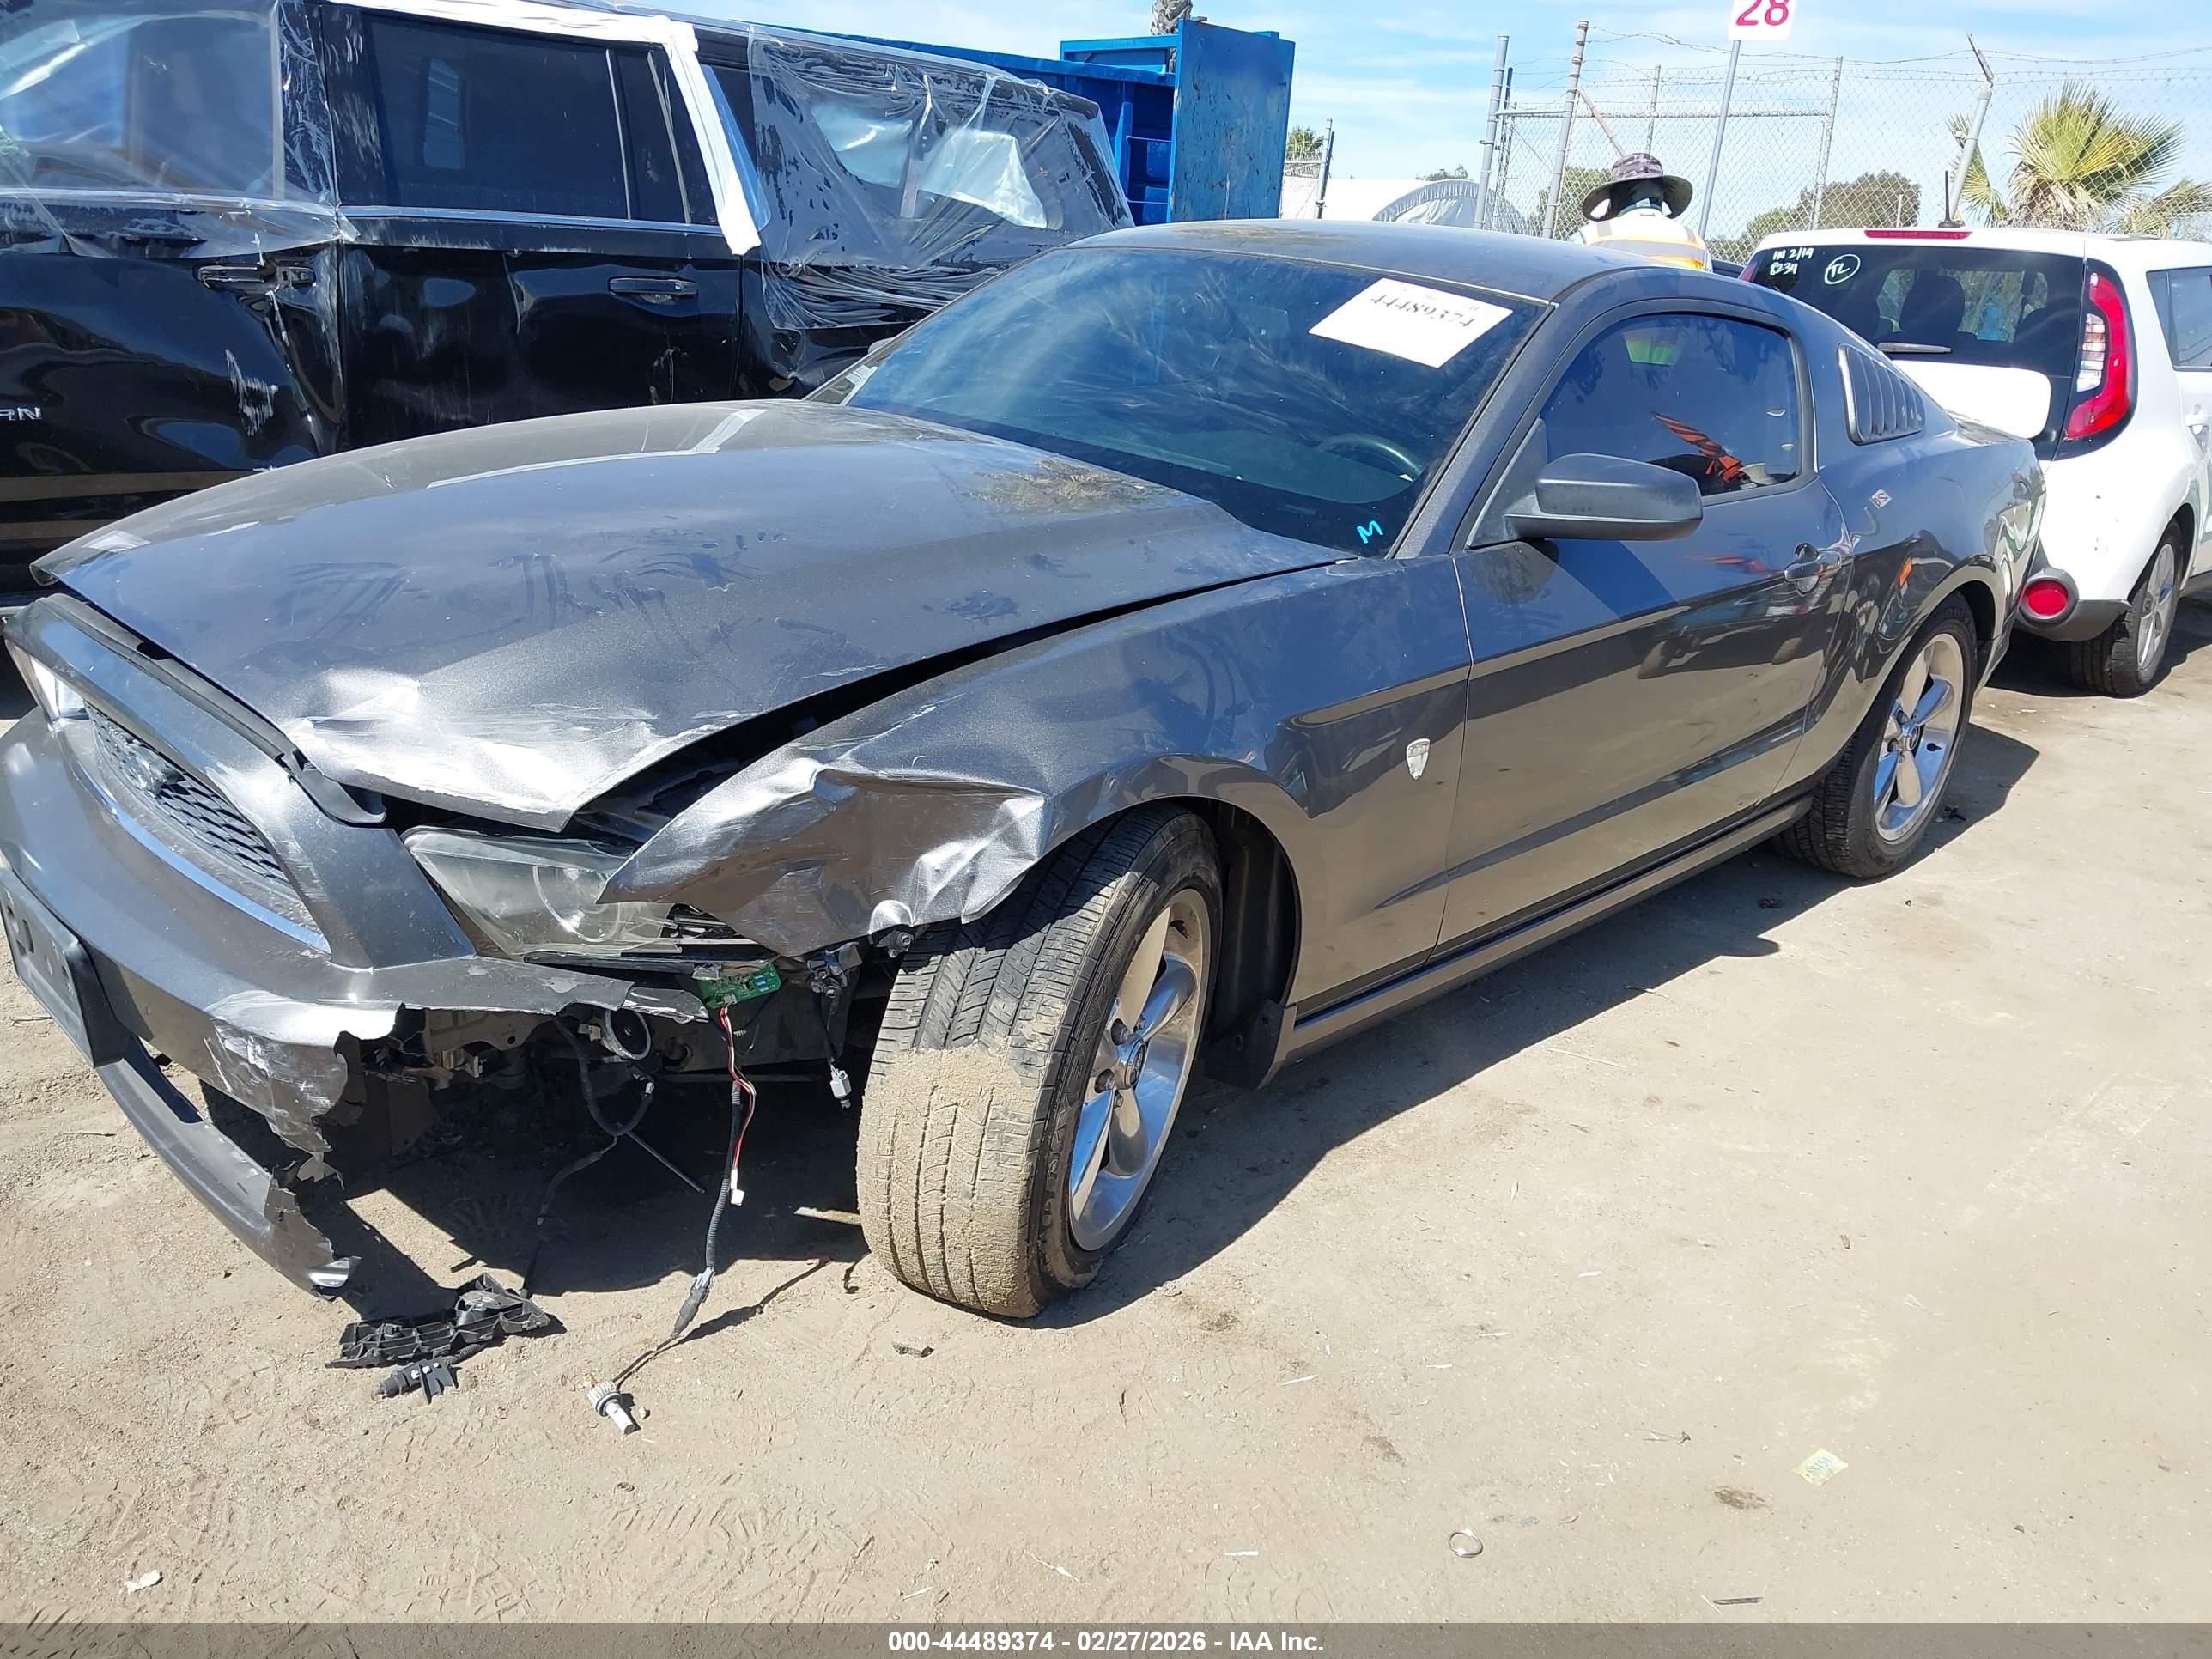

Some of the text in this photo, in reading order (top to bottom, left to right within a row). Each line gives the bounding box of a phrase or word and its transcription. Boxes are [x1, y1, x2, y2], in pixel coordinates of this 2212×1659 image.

[1736, 0, 1789, 26] 28
[1773, 247, 1814, 260] IN 2/19
[1370, 295, 1476, 327] 44489374
[1357, 520, 1384, 544] M
